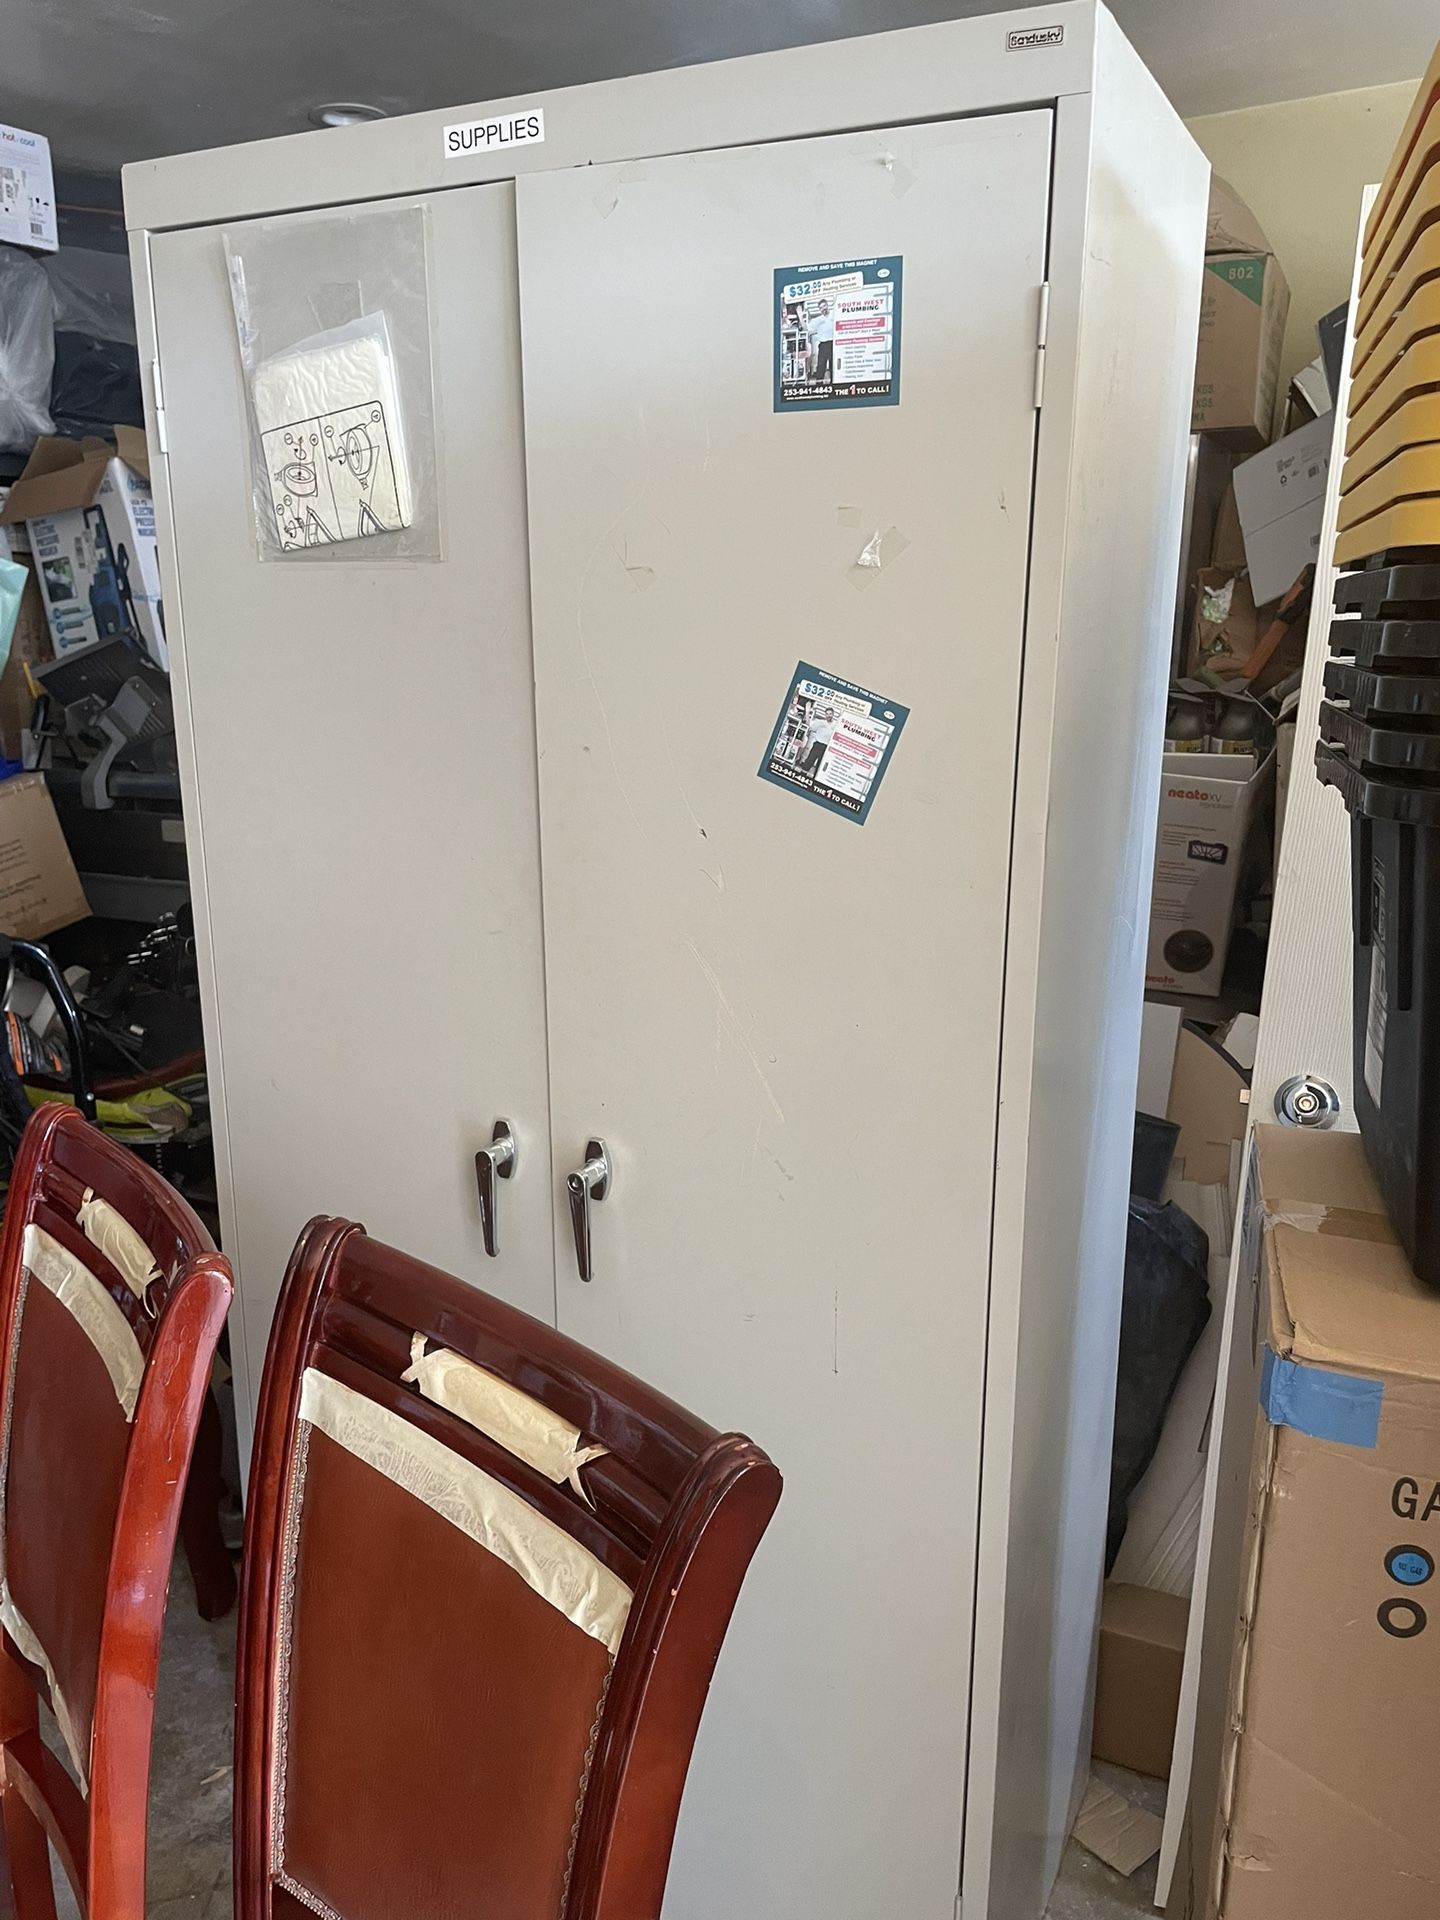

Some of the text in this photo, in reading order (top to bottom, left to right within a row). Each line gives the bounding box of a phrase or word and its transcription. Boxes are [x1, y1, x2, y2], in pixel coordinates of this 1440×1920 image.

[448, 116, 540, 151] SUPPLIES
[842, 304, 880, 313] PLUMBING
[784, 386, 833, 396] 253-941-4843
[850, 384, 856, 394] 1
[818, 671, 838, 682] REMOVE
[847, 683, 858, 692] SAVE
[859, 688, 869, 696] THIS
[869, 693, 888, 704] MAGNET
[841, 718, 882, 739] SOUTH WEST
[843, 724, 875, 742] PLUMBING
[770, 762, 813, 786] 253-941-4843
[813, 785, 826, 796] THE
[832, 793, 841, 802] TO
[1168, 788, 1208, 800] neato
